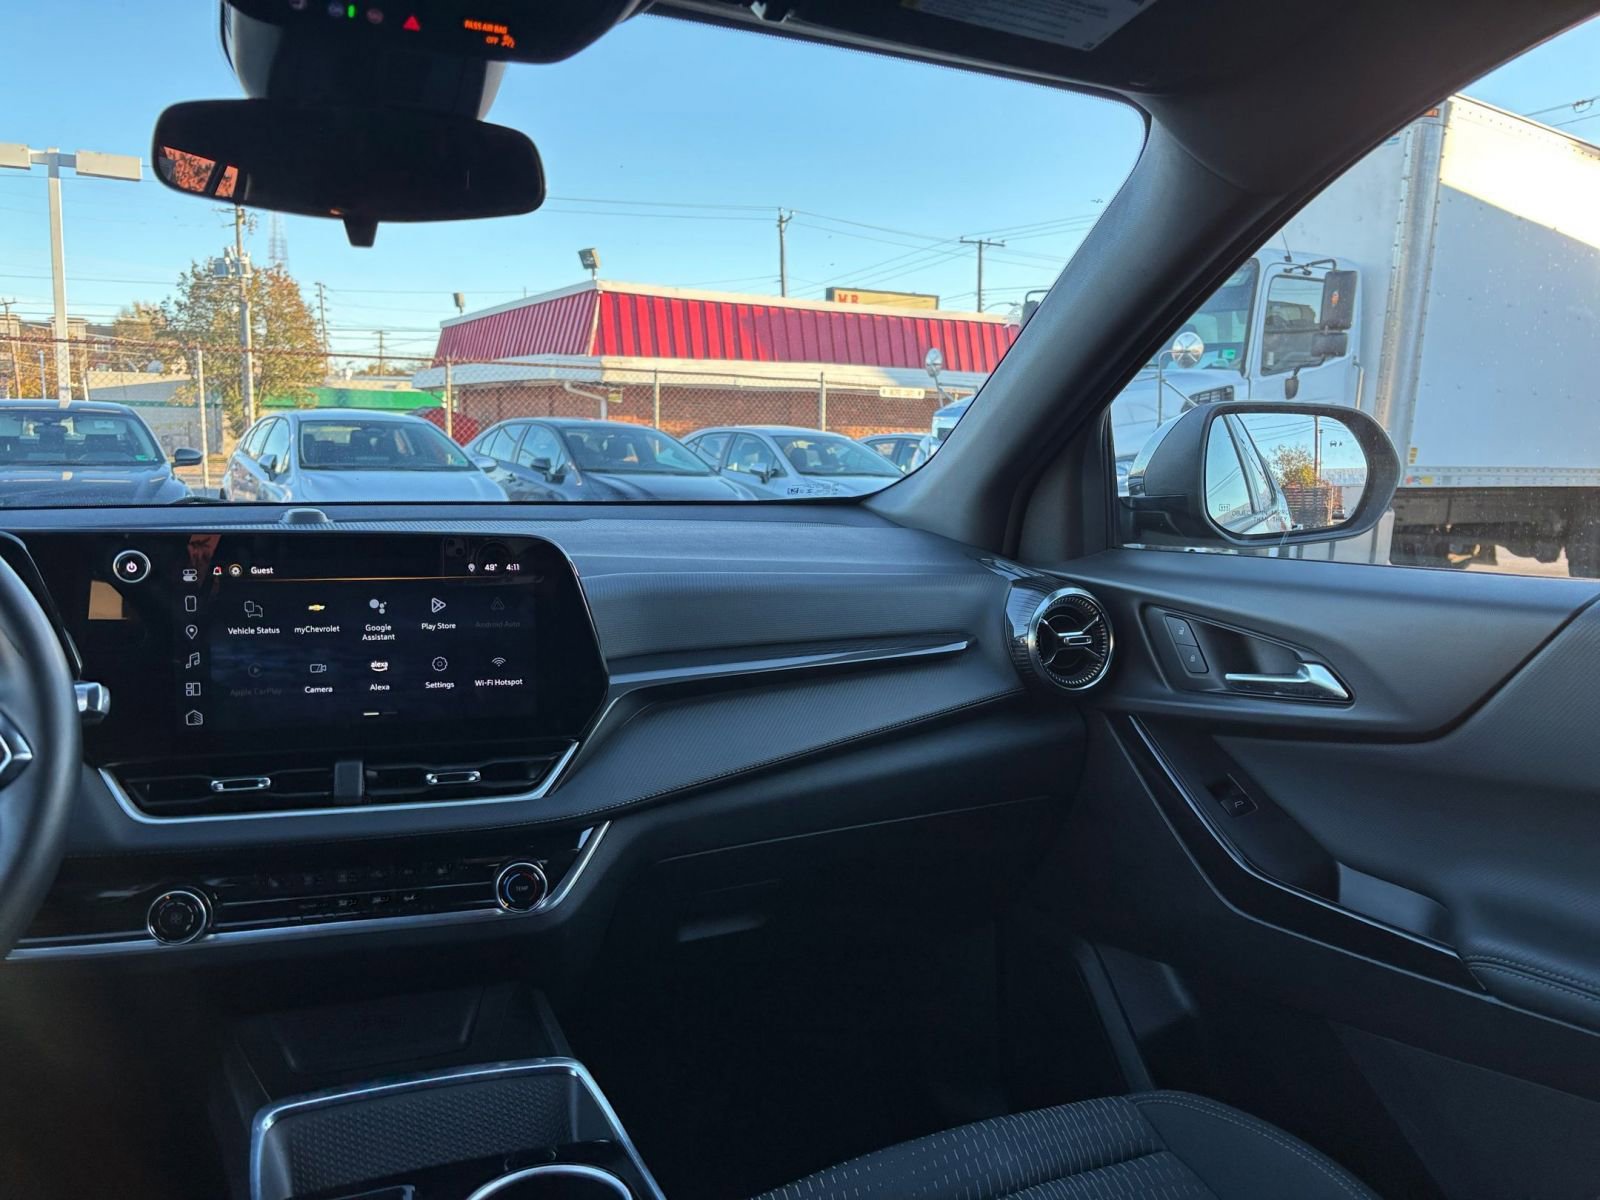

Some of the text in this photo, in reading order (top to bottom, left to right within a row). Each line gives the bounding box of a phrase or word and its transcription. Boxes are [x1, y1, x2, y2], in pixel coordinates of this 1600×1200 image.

[464, 19, 482, 30] PASS
[486, 36, 499, 45] OFF
[250, 566, 274, 575] Guest
[506, 563, 520, 571] 4:11
[228, 626, 280, 635] Vehicle Status
[294, 624, 340, 635] myChevrolet
[365, 624, 392, 632] Google
[421, 622, 436, 631] Play
[362, 633, 396, 641] Assistant
[370, 660, 389, 668] alexa
[425, 681, 455, 690] Settings
[495, 678, 523, 688] Hotspot
[304, 685, 334, 694] Camera
